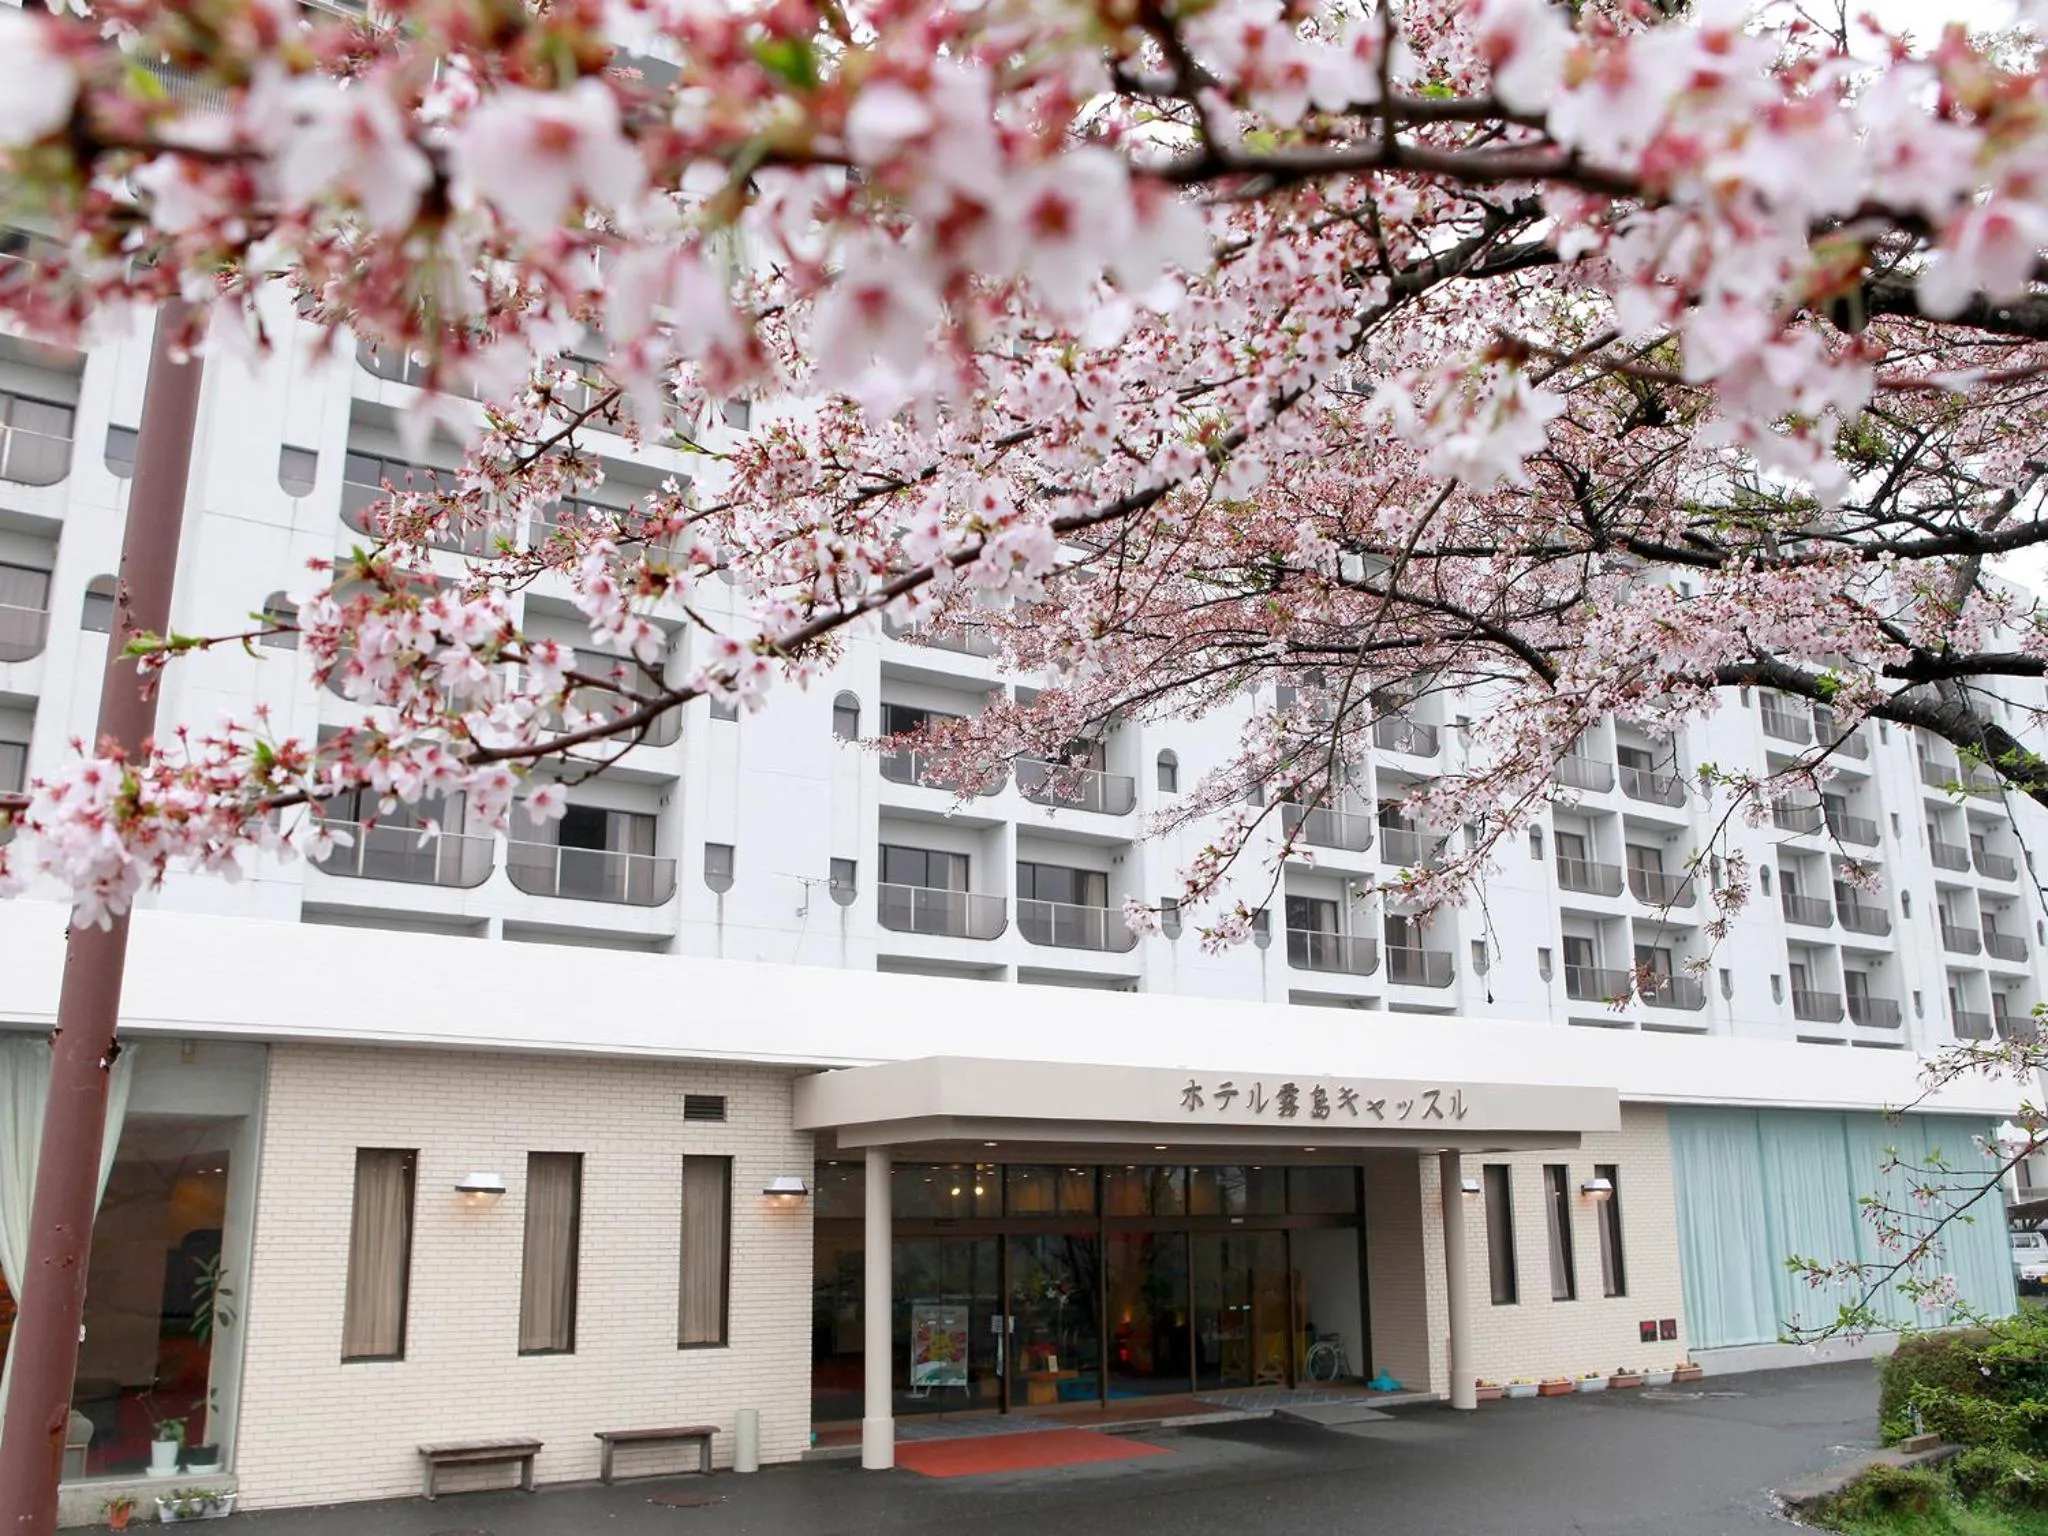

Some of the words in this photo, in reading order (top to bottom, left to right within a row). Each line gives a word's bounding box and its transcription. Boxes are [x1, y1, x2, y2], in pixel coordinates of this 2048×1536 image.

[1180, 1079, 1468, 1121] ホテル霧島キャッスル
